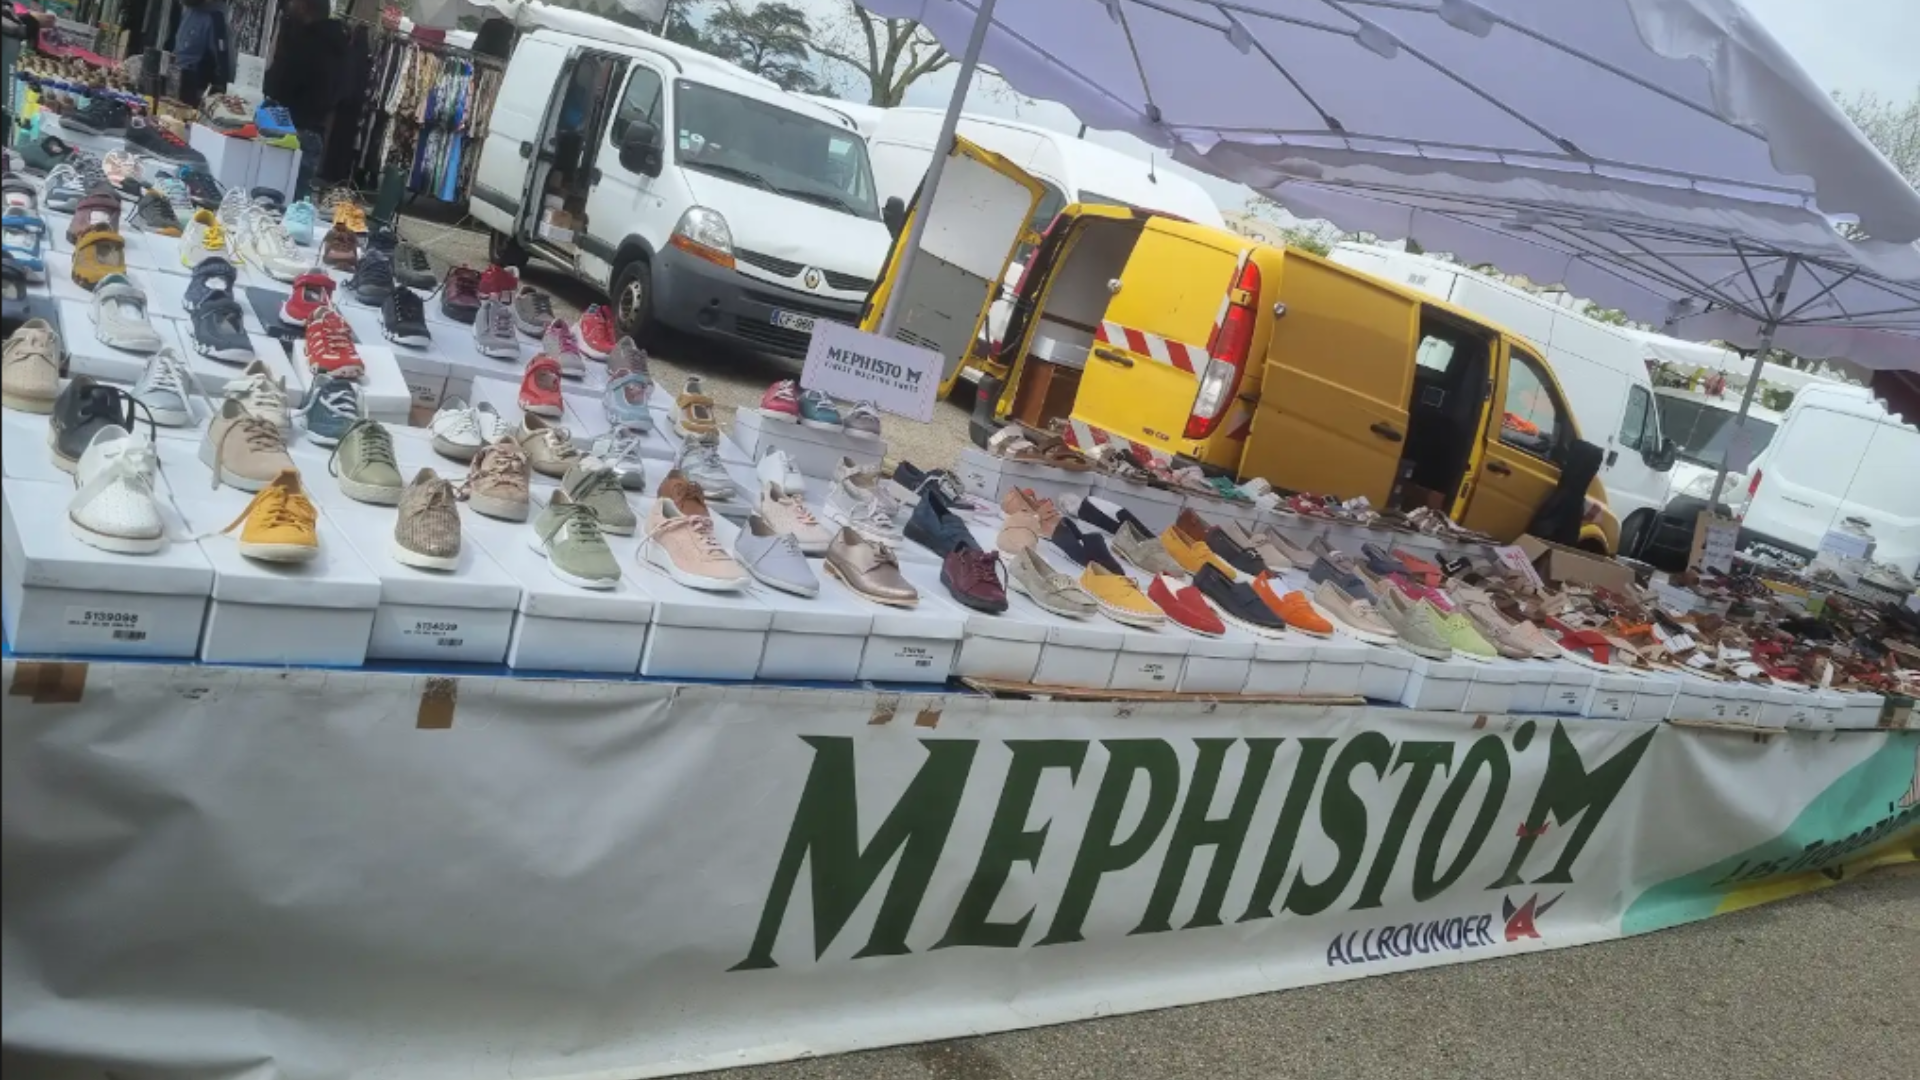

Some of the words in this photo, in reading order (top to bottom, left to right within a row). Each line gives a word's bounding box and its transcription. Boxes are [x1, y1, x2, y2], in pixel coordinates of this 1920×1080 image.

[826, 346, 902, 378] MEPHISTO
[726, 732, 1511, 973] MEPHISTO
[1326, 913, 1496, 967] ALLROUNDER
